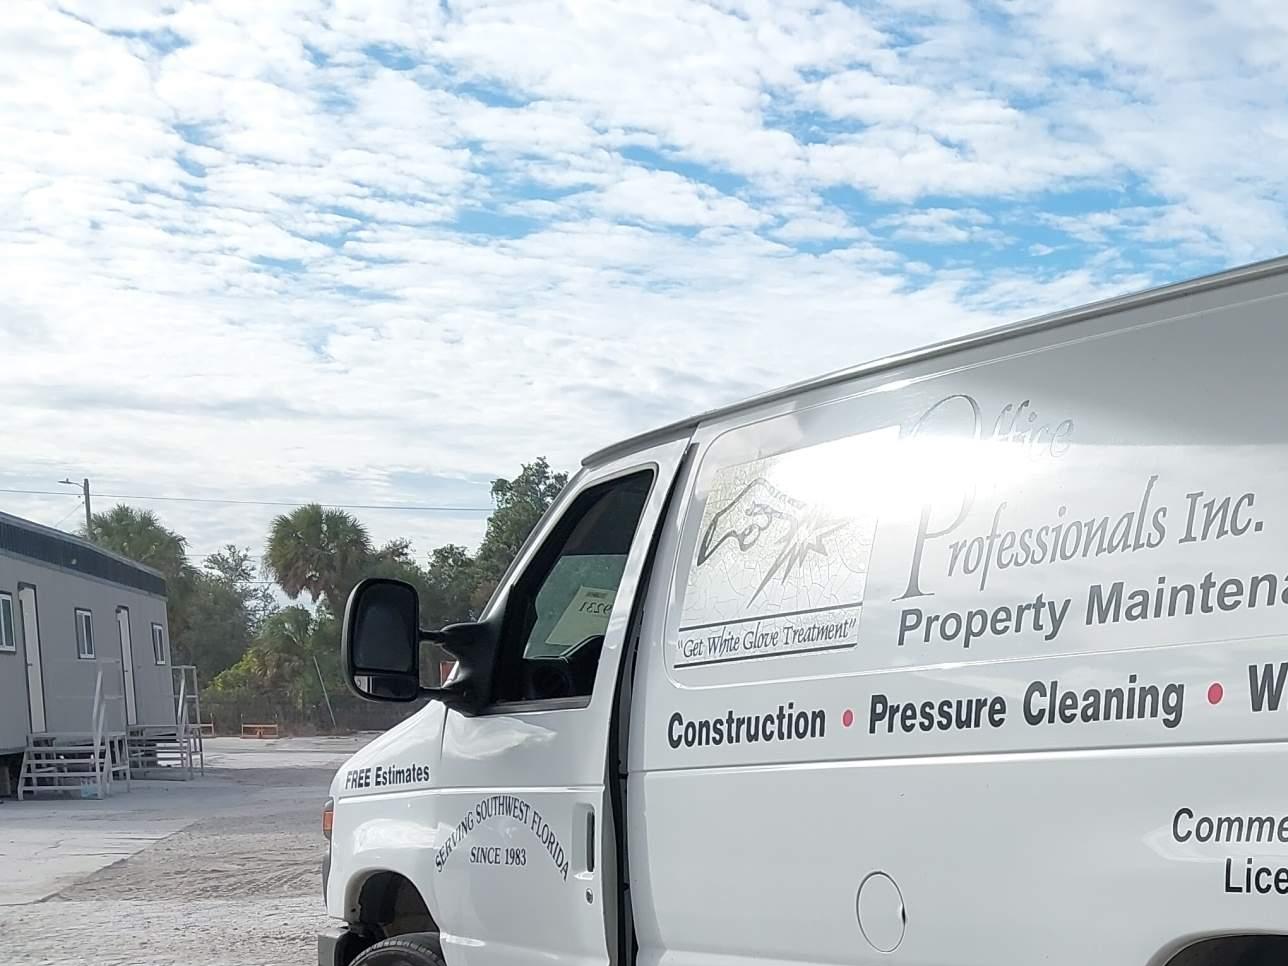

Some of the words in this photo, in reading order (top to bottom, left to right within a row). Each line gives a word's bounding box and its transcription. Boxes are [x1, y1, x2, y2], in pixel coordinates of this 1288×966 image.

[891, 474, 1168, 602] Professionals
[1178, 490, 1264, 545] Inc.
[707, 626, 741, 658] White
[742, 621, 779, 651] Glove
[897, 593, 1072, 648] Property
[667, 702, 827, 749] Construction
[868, 693, 1007, 734] Pressure
[1022, 673, 1185, 729] Cleaning
[345, 767, 372, 789] FREE
[375, 763, 430, 786] Estimates
[435, 811, 475, 873] SERVING
[475, 795, 531, 825] SOUTHWEST
[530, 810, 569, 882] FLORIDA
[469, 846, 502, 864] SINCE
[504, 847, 527, 866] 1983
